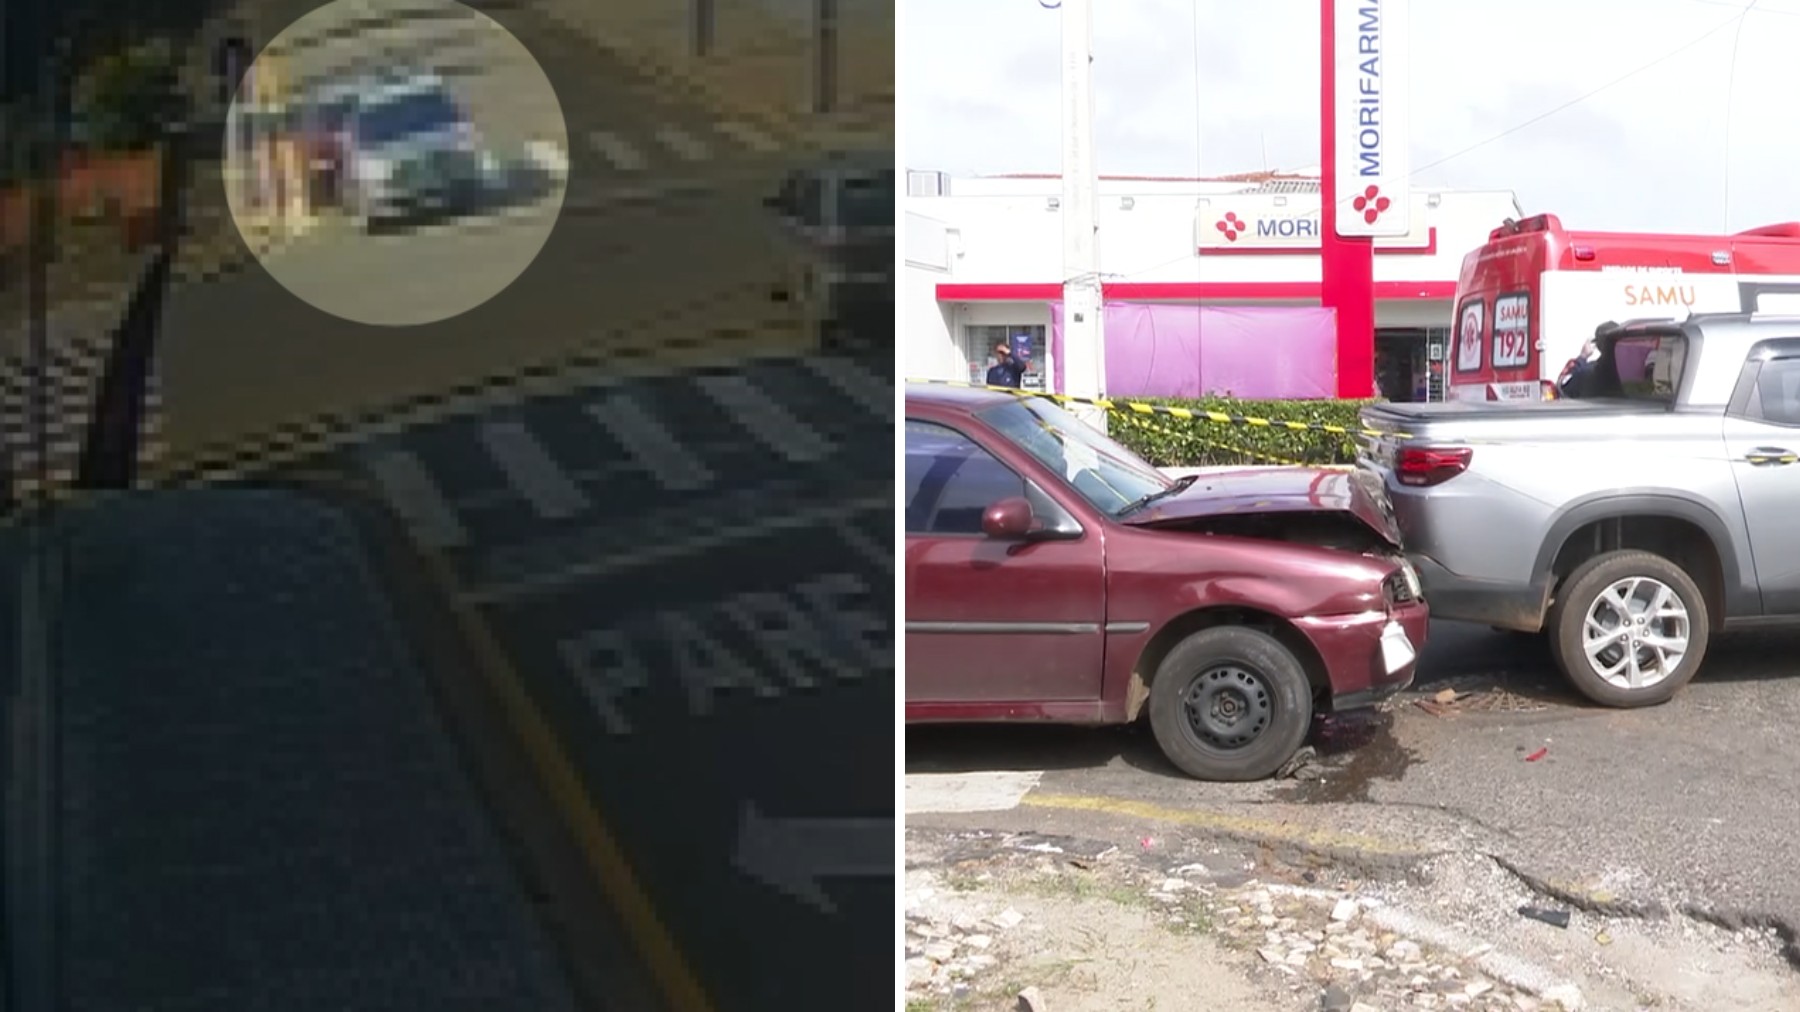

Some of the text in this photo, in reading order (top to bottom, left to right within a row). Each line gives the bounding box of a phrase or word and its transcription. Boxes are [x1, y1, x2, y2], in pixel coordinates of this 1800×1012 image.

[1358, 0, 1380, 177] MORIFARM
[1257, 219, 1319, 237] MORI
[1624, 285, 1696, 306] SAMU
[1500, 303, 1527, 322] SAMU
[1500, 329, 1526, 358] 192
